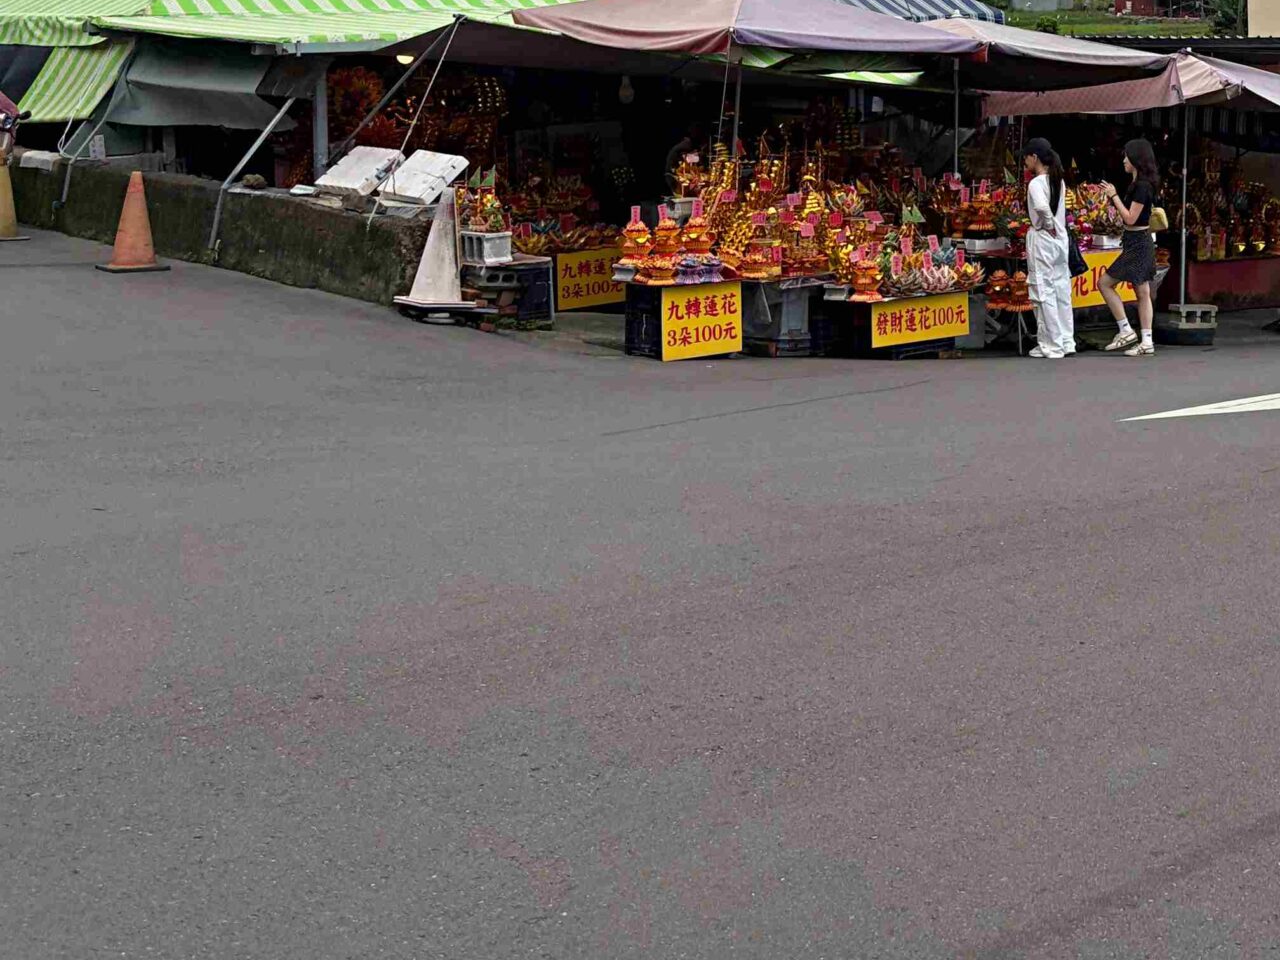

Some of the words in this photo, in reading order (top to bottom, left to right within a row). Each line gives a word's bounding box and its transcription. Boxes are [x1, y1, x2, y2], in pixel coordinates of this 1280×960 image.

[667, 293, 738, 321] 九轉蓮花
[877, 304, 967, 336] 發財蓮花100元
[667, 321, 738, 347] 3朵100元
